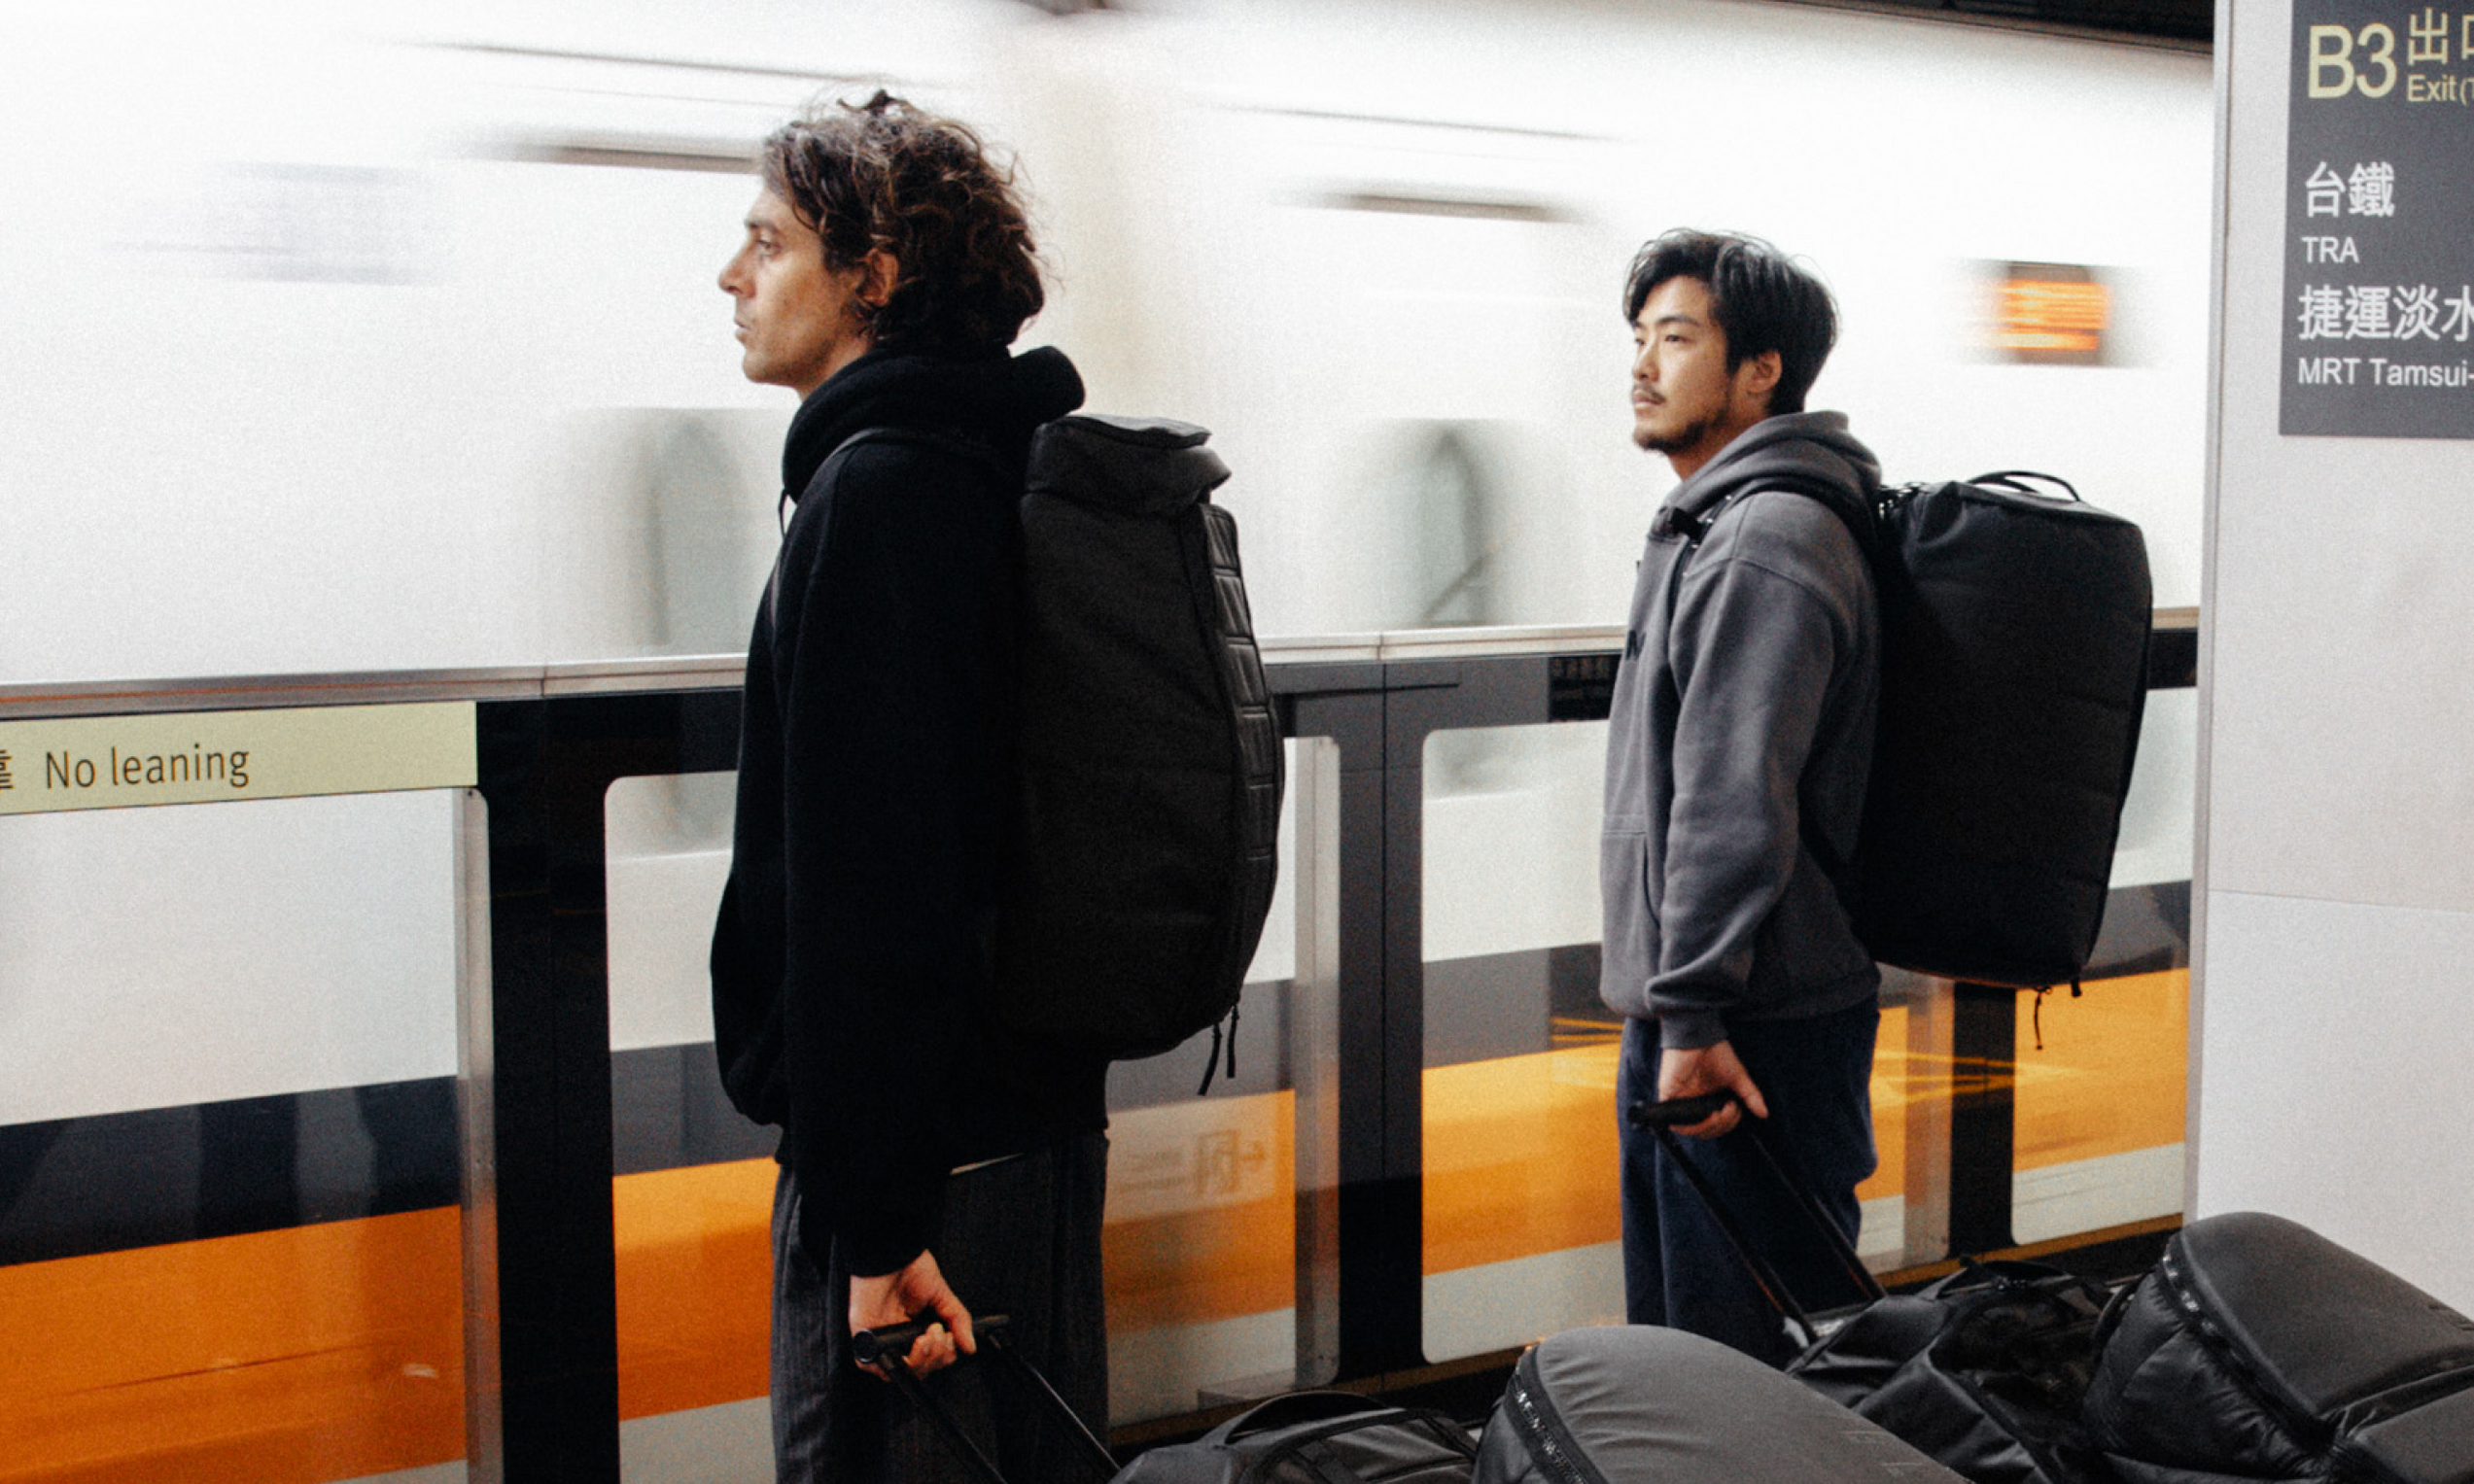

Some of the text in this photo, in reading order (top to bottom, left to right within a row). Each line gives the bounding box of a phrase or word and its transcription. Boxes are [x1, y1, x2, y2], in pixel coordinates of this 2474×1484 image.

[2308, 23, 2397, 98] B3
[2305, 161, 2395, 218] 台鐵
[2301, 236, 2360, 263] TRA
[2298, 357, 2361, 385] MRT
[46, 751, 95, 789] No
[111, 742, 250, 788] leaning
